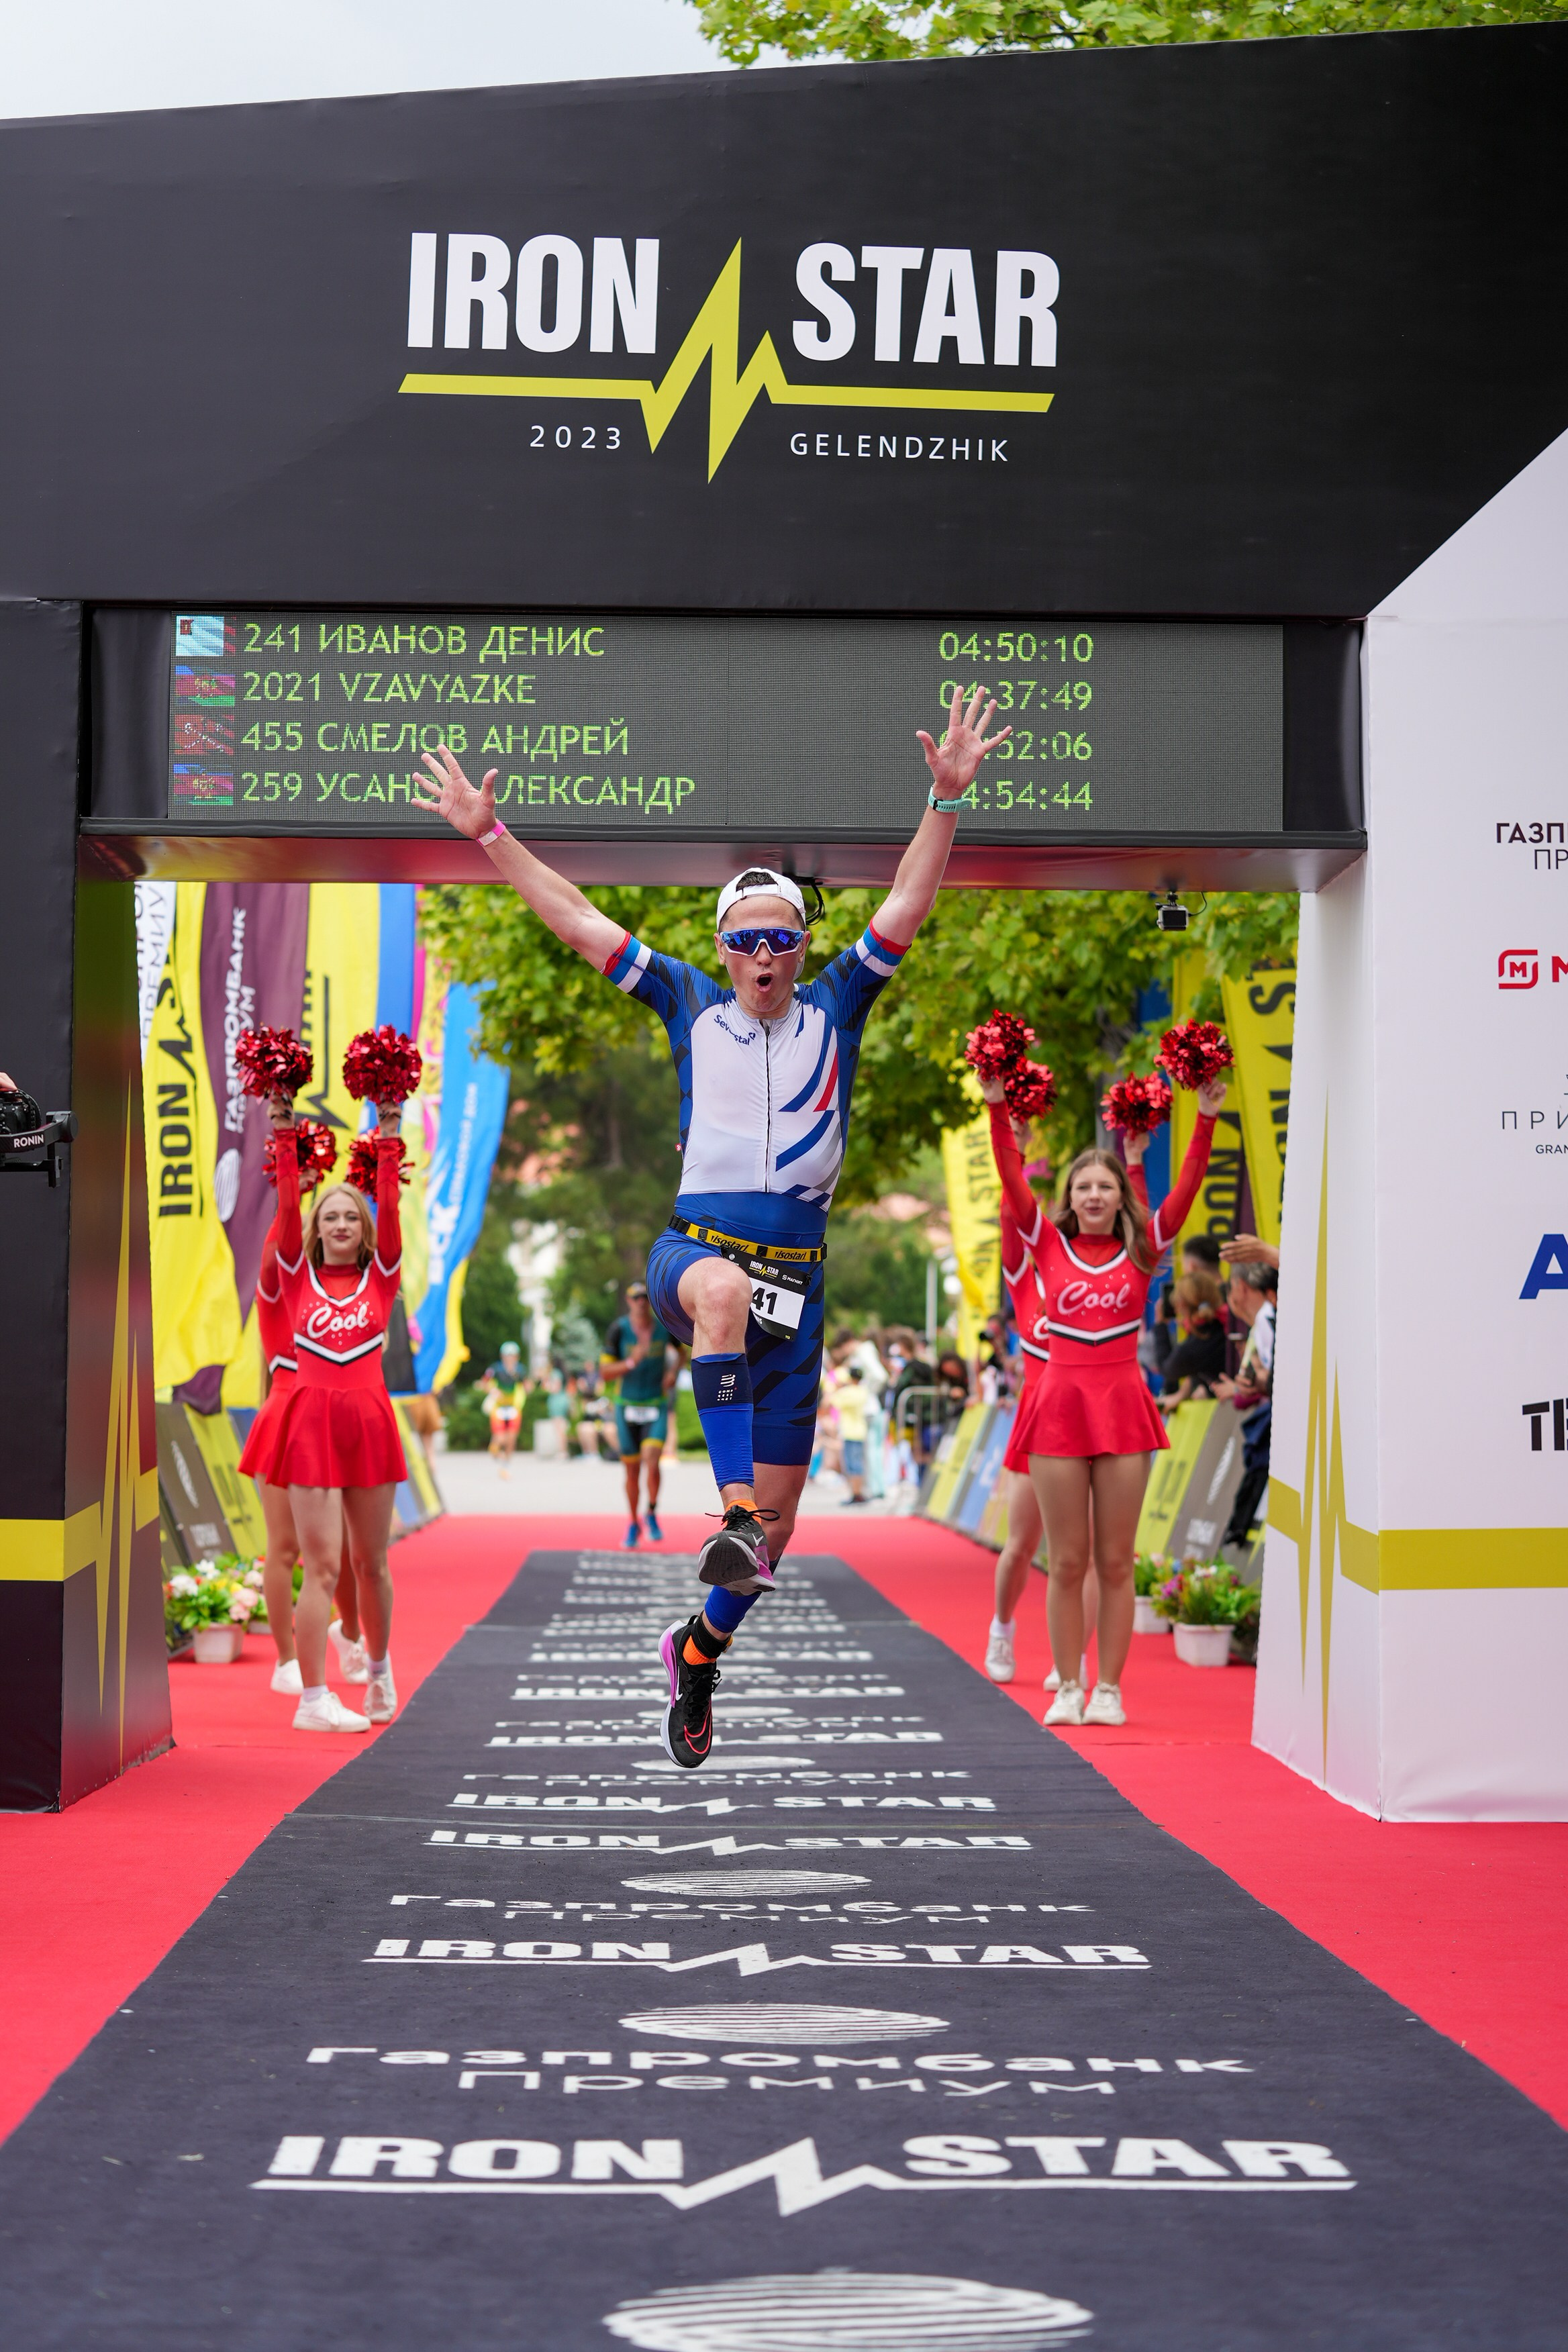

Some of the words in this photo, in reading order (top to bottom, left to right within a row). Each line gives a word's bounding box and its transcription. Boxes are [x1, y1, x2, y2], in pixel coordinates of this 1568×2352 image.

[406, 232, 660, 354] IRON
[792, 242, 1060, 368] STAR
[529, 424, 622, 450] 2023
[791, 432, 1009, 462] GELENDZHIK
[244, 623, 302, 654] 241
[319, 624, 467, 654] ИВАНОВ
[479, 626, 605, 663] ДЕНИС
[939, 631, 1093, 662] 04:50:10
[242, 671, 321, 702] 2021
[340, 672, 536, 703] VZAVYAZKE
[939, 679, 1093, 710] 04:37:49
[240, 722, 303, 752] 455
[317, 722, 468, 753] СМЕЛОВ
[481, 718, 628, 763] АНДРЕЙ
[939, 730, 1093, 761] :52:06
[240, 772, 303, 802] 259
[316, 773, 452, 803] УСАНО
[481, 774, 695, 815] ЛЕКСАНДР
[961, 780, 1093, 810] 4:54:44
[1496, 822, 1568, 844] ГАЗП
[13, 1134, 44, 1148] RONIN
[158, 1083, 193, 1218] IRON
[750, 1260, 763, 1270] IRON
[767, 1266, 779, 1276] STAR
[1057, 1280, 1131, 1315] Cool
[307, 1303, 370, 1339] Cool
[451, 1793, 661, 1806] IRON
[773, 1796, 997, 1808] STAR
[429, 1830, 660, 1847] IRON
[783, 1836, 1032, 1847] STAR
[389, 1895, 1097, 1912] Газпромбанк
[503, 1911, 991, 1924] Премиум
[373, 1939, 671, 1959] IRON
[828, 1943, 1150, 1963] STAR
[307, 2047, 1255, 2073] Газпромбанк
[458, 2071, 1116, 2097] Премиум
[266, 2135, 685, 2179] IRON
[902, 2135, 1351, 2177] STAR
